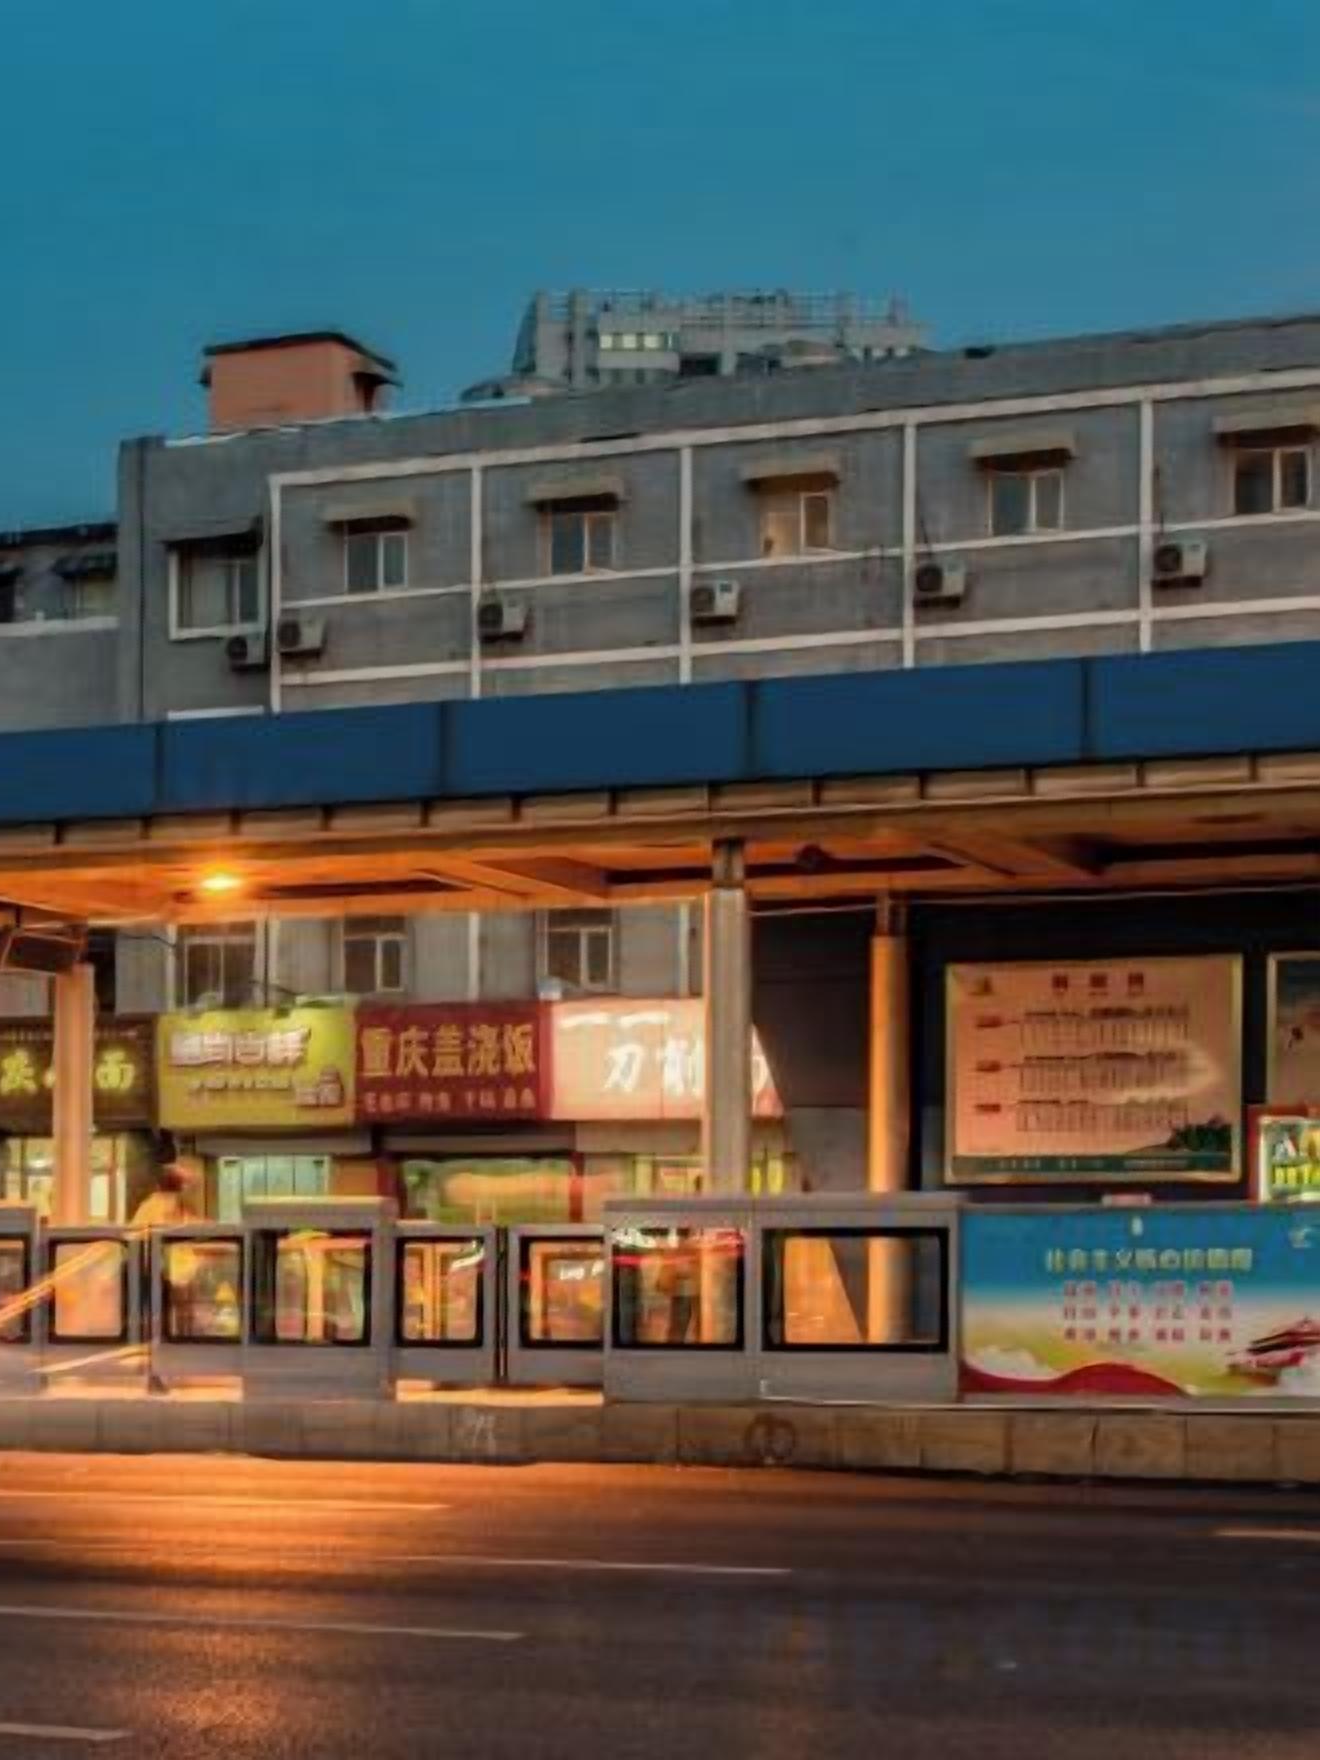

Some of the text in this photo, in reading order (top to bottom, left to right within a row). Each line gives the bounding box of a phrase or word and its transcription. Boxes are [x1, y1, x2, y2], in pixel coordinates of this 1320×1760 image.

[361, 1023, 536, 1077] 重庆盖浇饭
